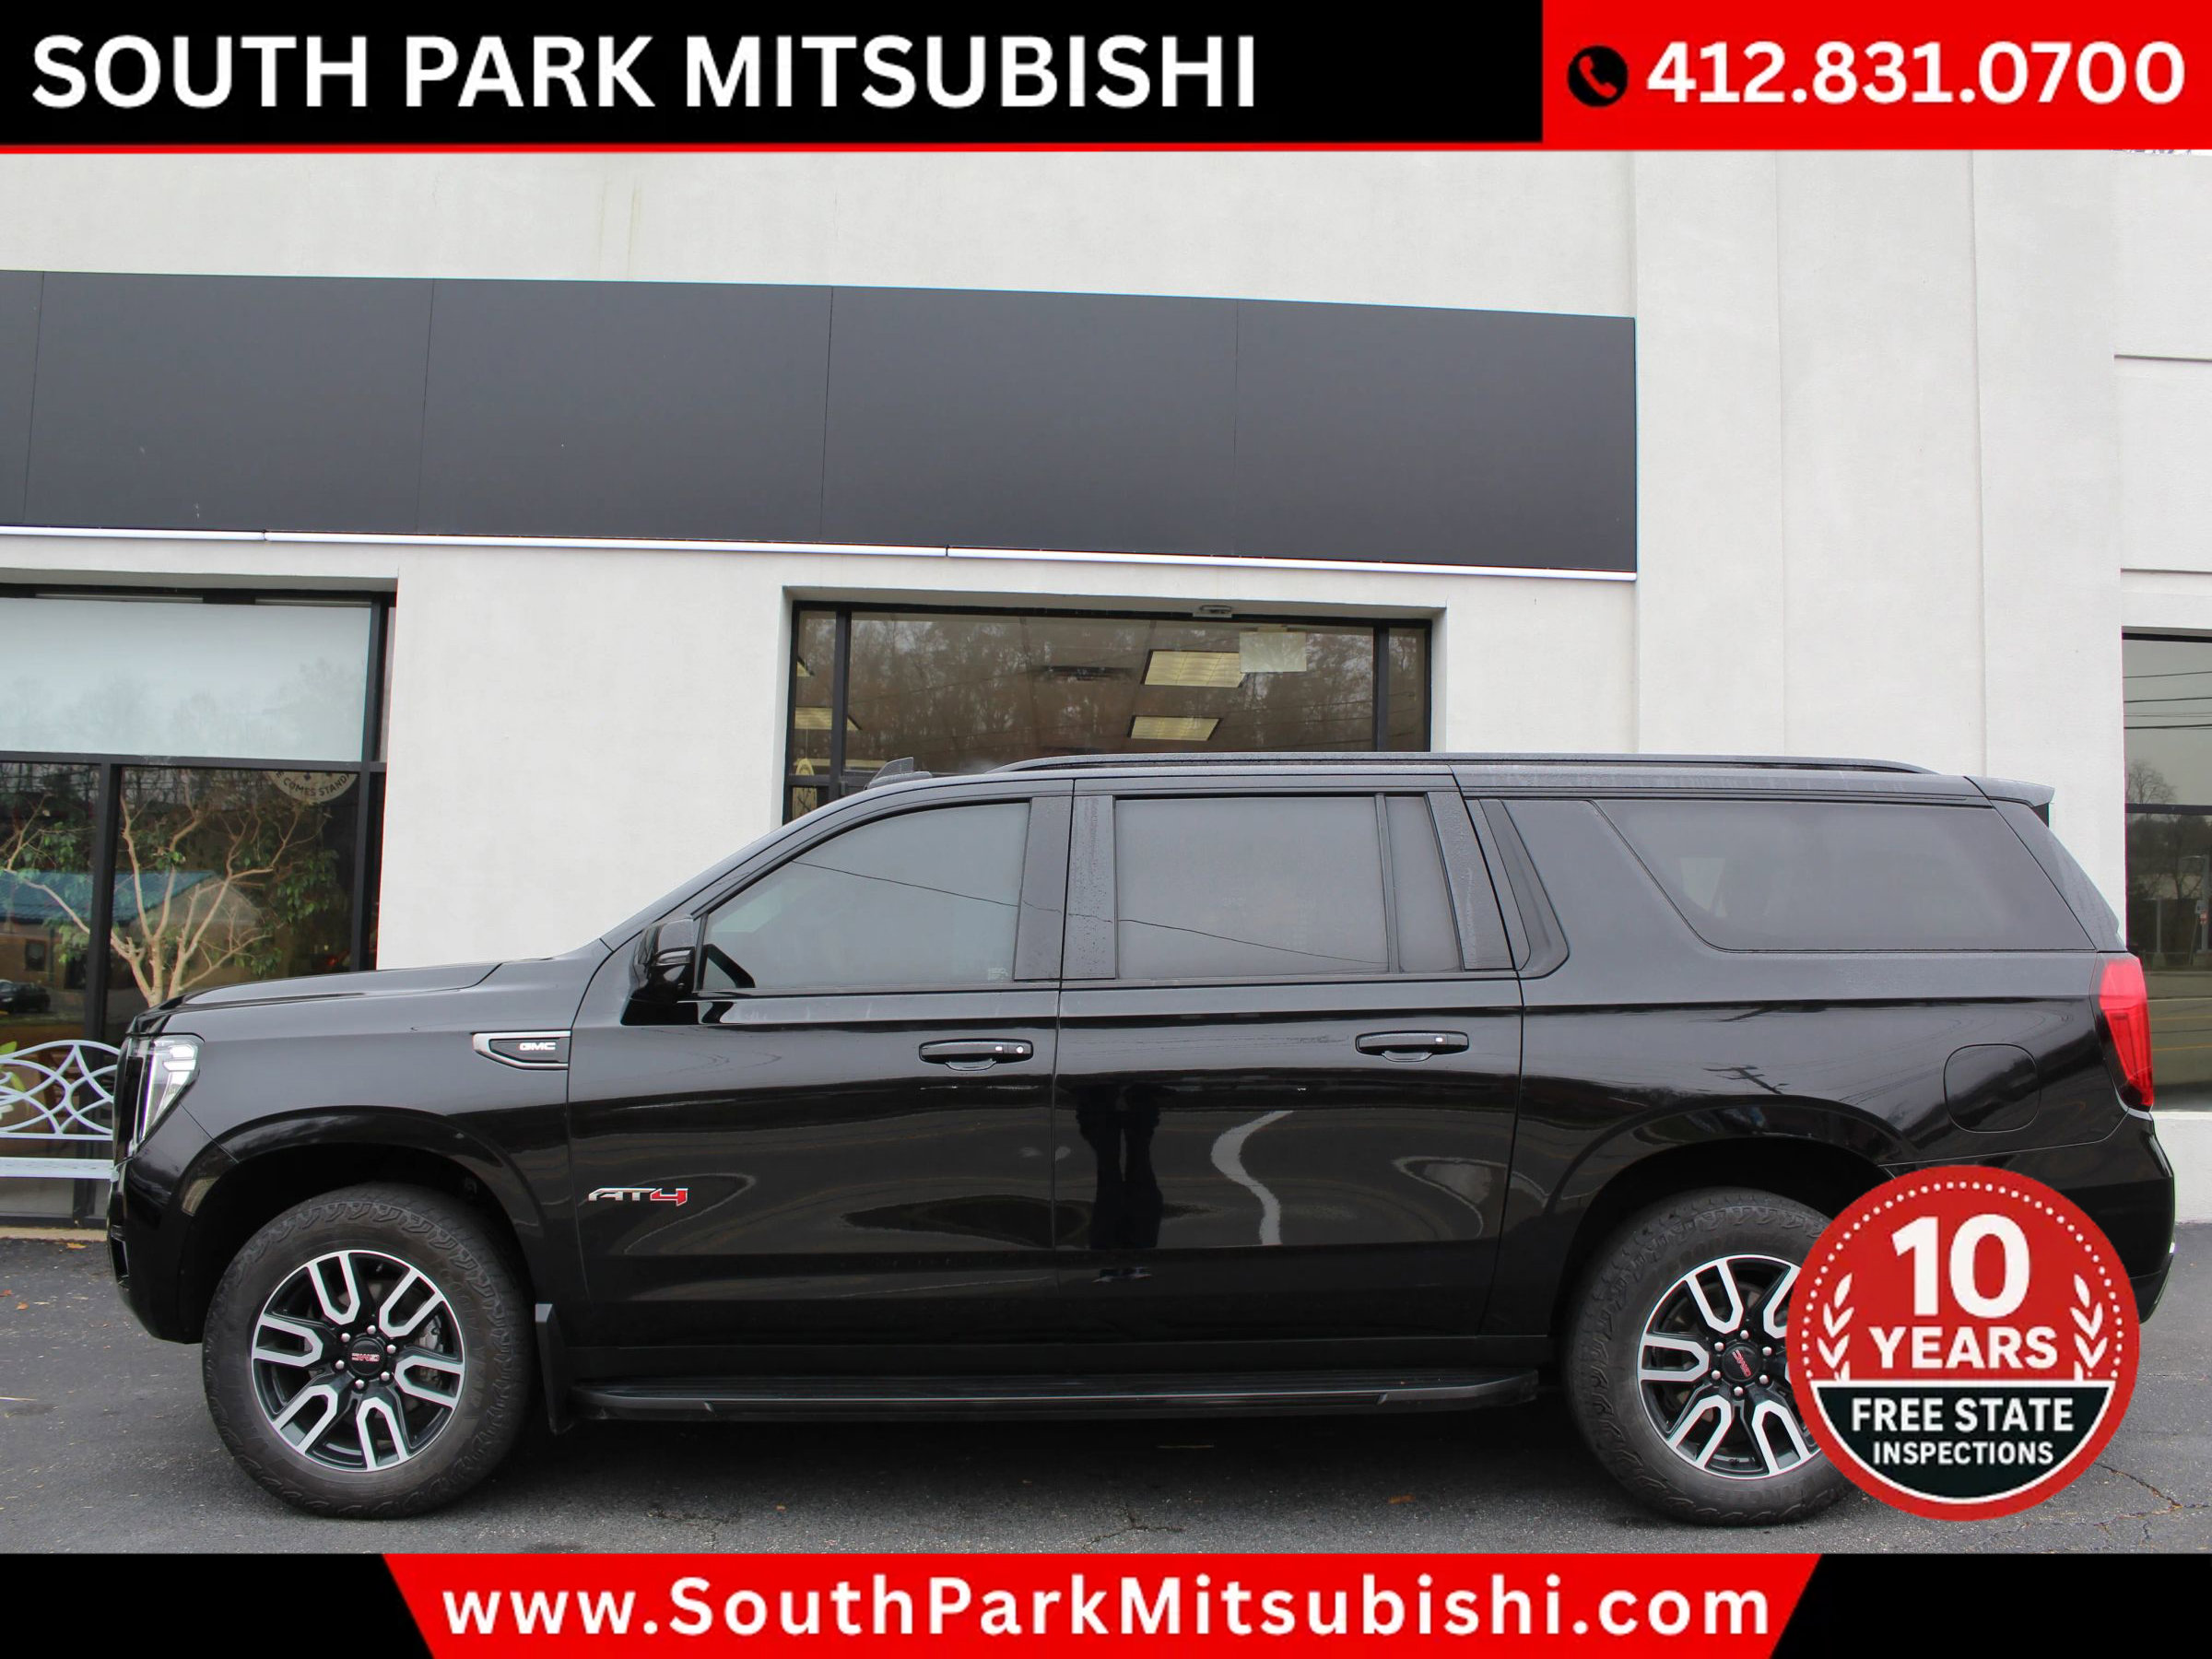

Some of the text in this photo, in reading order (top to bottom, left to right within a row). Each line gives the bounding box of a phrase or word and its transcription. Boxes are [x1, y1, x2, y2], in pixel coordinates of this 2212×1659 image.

[283, 777, 317, 796] COMES
[519, 1041, 557, 1051] GMC
[587, 1187, 689, 1206] AT4
